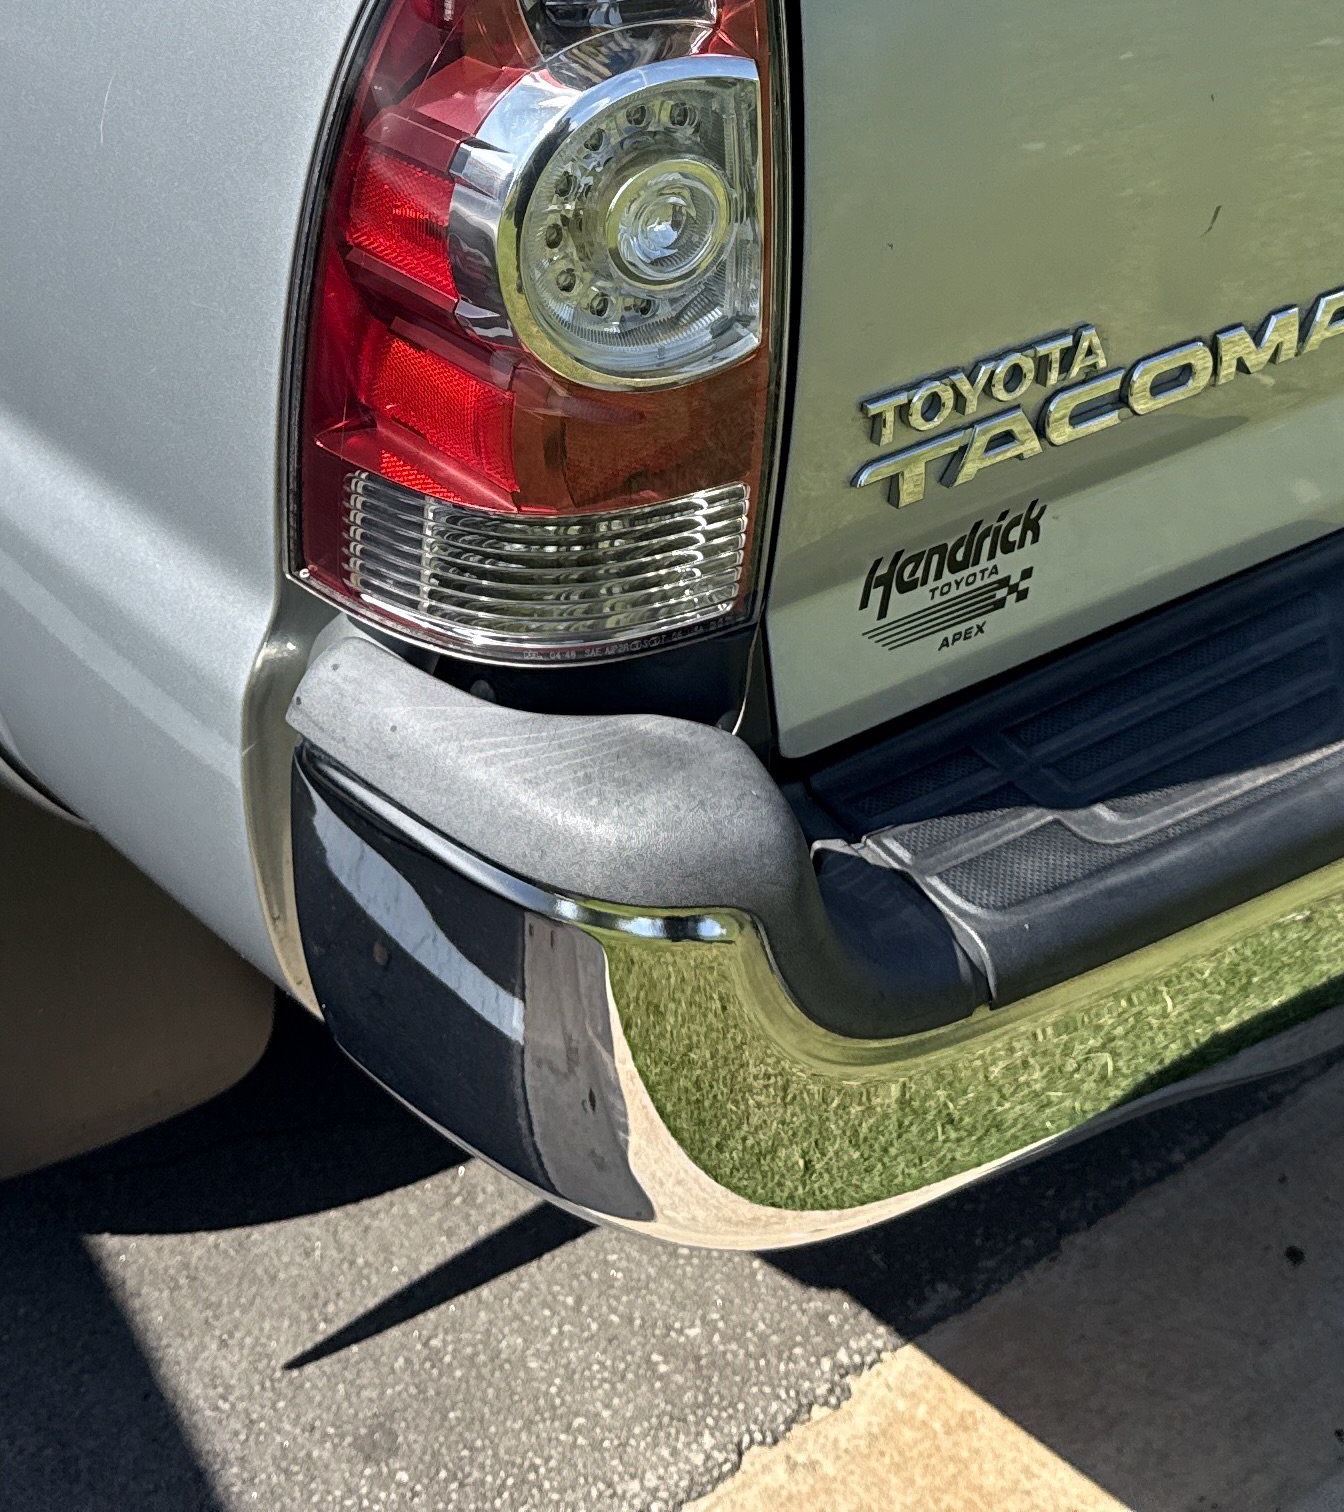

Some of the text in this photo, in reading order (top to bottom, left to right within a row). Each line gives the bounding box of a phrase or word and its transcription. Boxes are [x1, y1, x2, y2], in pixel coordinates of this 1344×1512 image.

[861, 323, 1108, 445] TOYOTA
[859, 499, 1047, 621] Hendrick
[929, 564, 999, 600] TOYOTA
[938, 621, 986, 651] APEX
